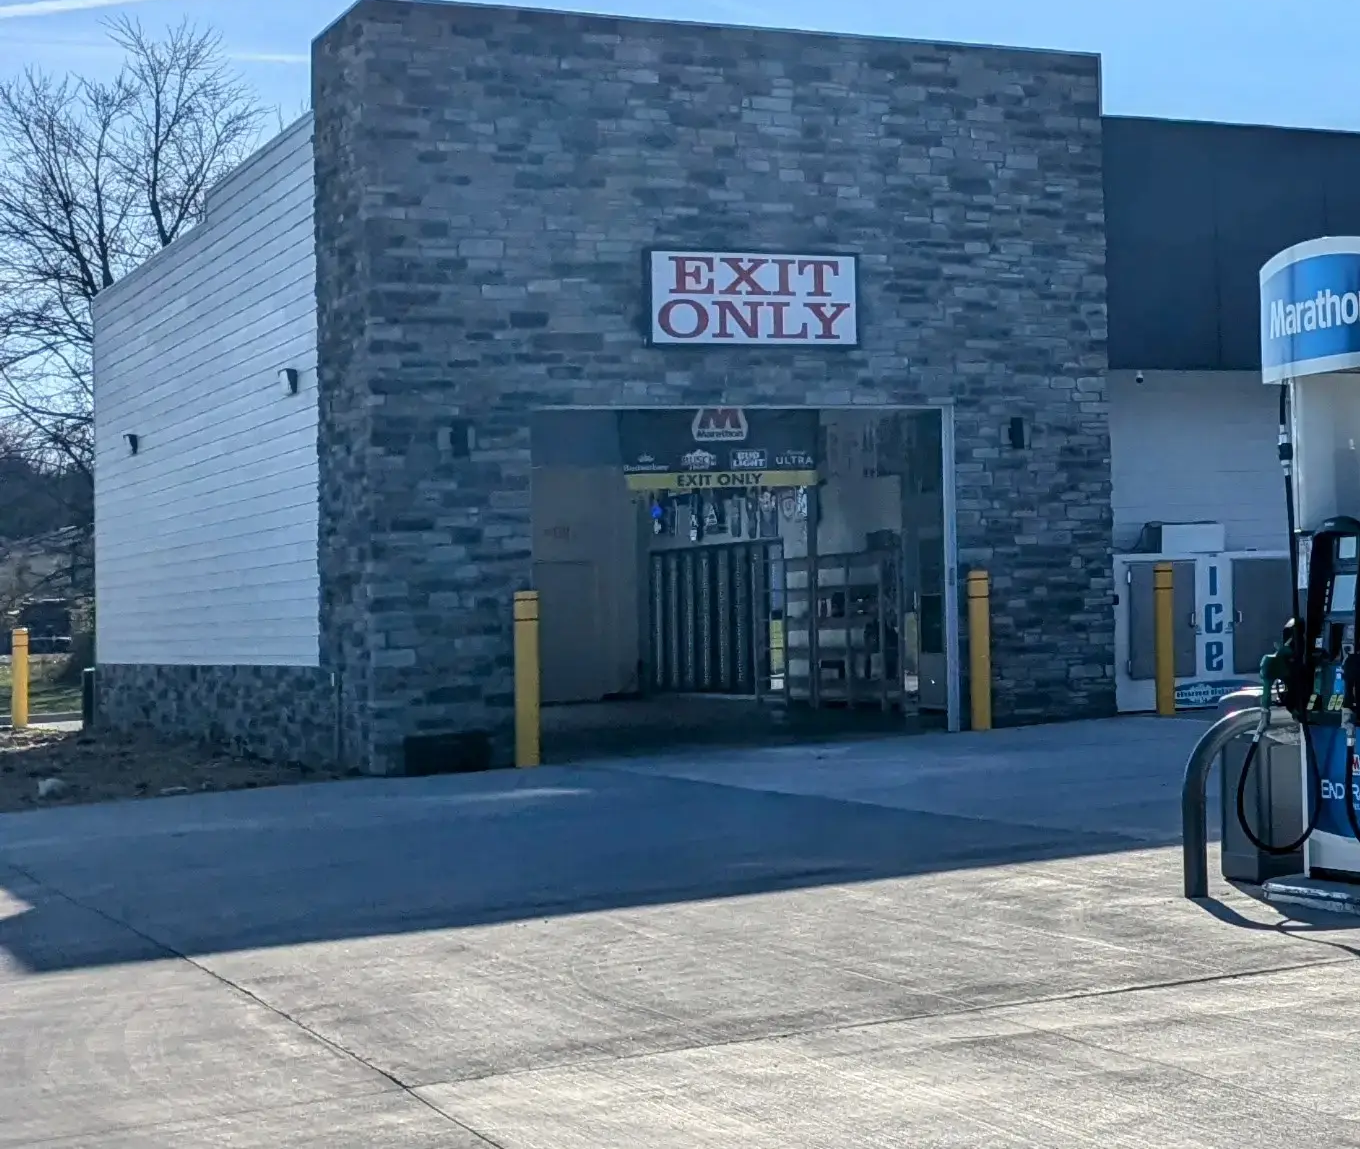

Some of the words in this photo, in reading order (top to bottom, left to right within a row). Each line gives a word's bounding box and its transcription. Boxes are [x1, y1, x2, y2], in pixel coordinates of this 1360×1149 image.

[668, 255, 839, 297] EXIT
[657, 298, 850, 340] ONLY
[732, 458, 766, 468] LIGHT
[775, 456, 814, 466] ULTRA
[677, 474, 712, 488] EXIT
[717, 473, 763, 487] ONLY
